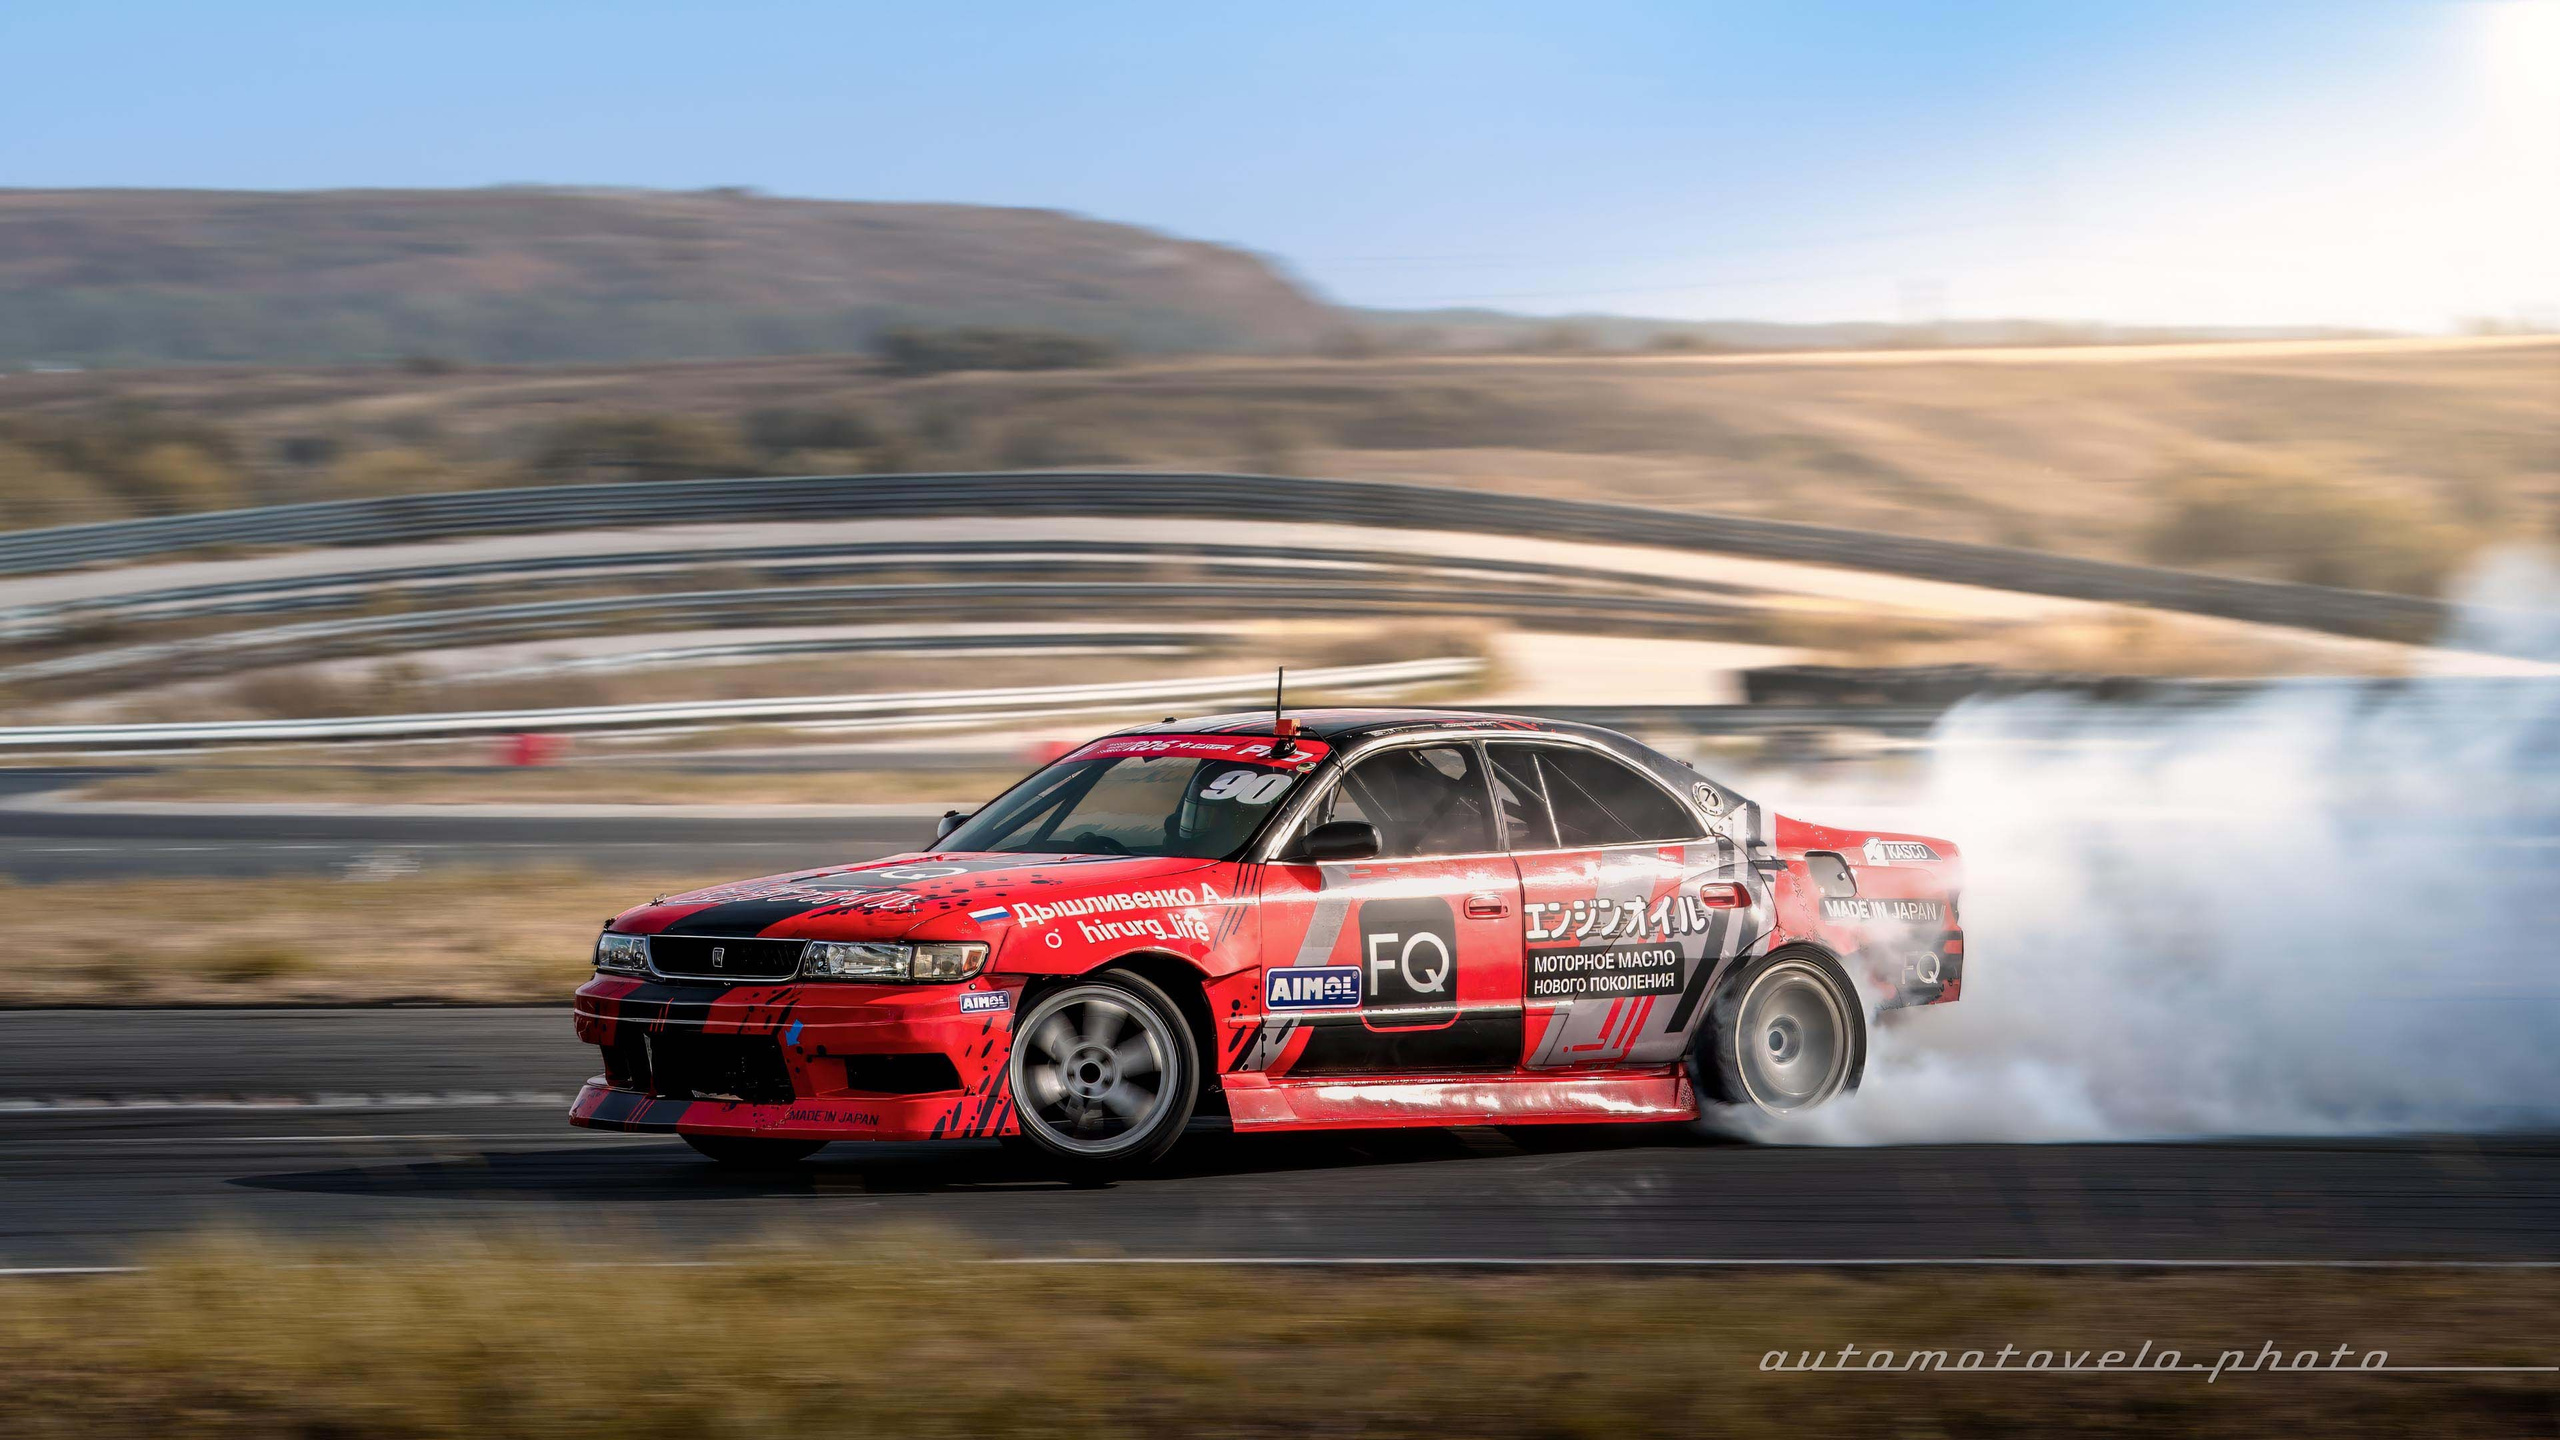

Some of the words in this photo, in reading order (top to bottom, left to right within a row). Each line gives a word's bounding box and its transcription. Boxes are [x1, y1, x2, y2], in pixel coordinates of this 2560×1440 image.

[1200, 770, 1293, 804] 90
[1886, 843, 1929, 860] KASCO
[1011, 888, 1196, 928] Дышливенко
[1523, 895, 1708, 941] エンジンオイル
[1824, 899, 1871, 919] MADE
[1871, 901, 1888, 919] IN
[1891, 901, 1937, 921] JAPAN
[1077, 913, 1210, 944] hirurg_life
[1368, 931, 1450, 995] FQ
[1534, 953, 1615, 973] МОТОРНОЕ
[1618, 949, 1676, 969] МАСЛО
[1902, 951, 1941, 985] FQ
[1270, 975, 1357, 1001] AIMOL
[1533, 977, 1587, 995] НОВОГО
[1590, 972, 1675, 992] ПОКОЛЕНИЯ
[788, 1110, 822, 1121] MADE
[823, 1110, 837, 1122] IN
[838, 1111, 880, 1126] JAPAN
